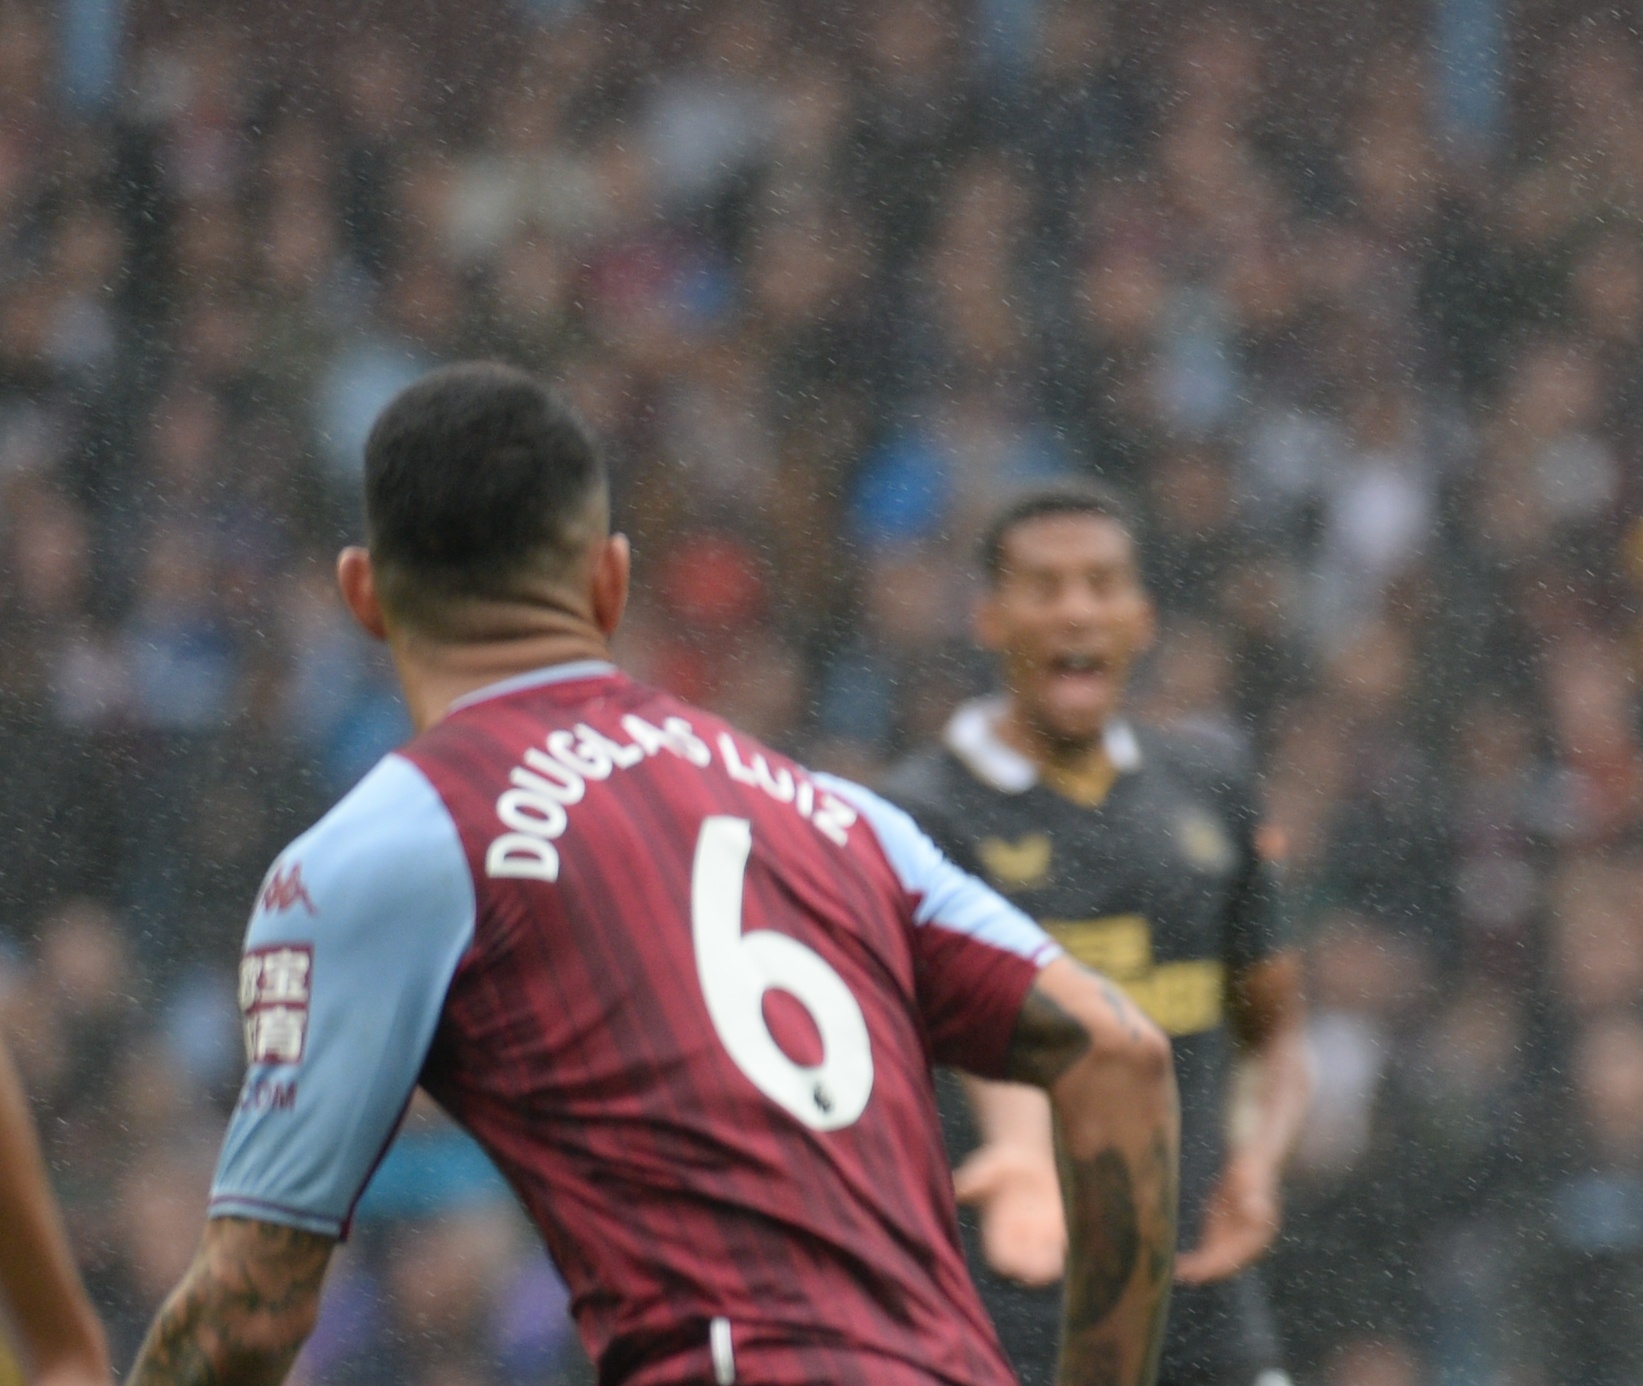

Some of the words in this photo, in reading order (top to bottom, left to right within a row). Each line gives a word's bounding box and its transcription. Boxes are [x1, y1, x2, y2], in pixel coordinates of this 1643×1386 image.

[484, 713, 711, 883] DOUGLAS
[716, 731, 858, 847] LUIZ
[690, 815, 874, 1131] 6
